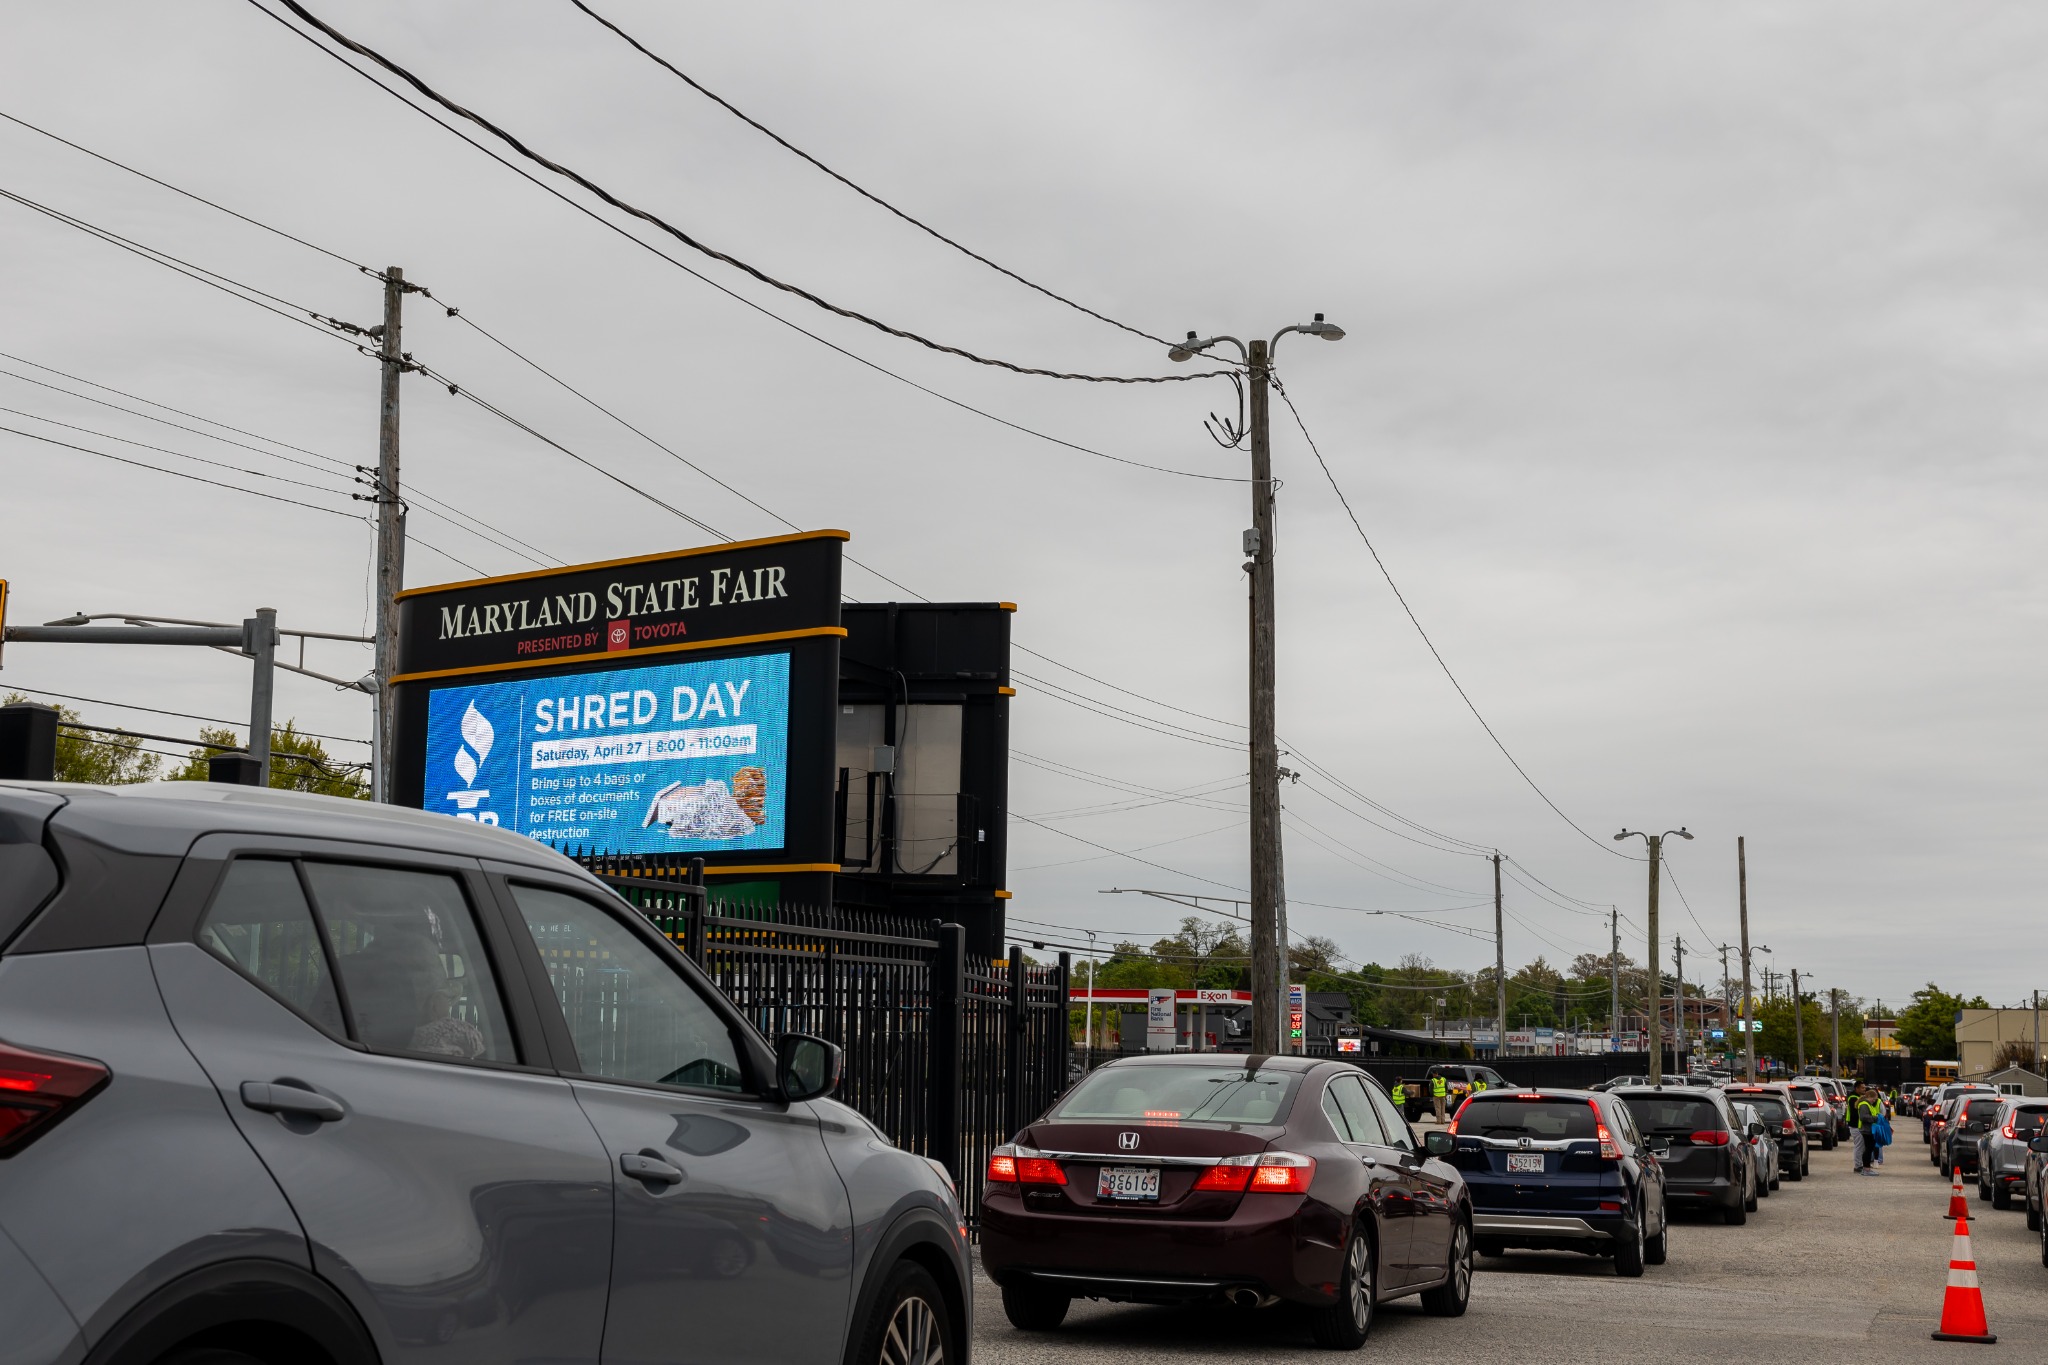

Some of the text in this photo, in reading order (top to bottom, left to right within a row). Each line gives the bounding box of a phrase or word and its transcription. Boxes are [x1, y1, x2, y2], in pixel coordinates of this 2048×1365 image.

[439, 565, 789, 641] MARYLAND STATE FAIR
[517, 621, 687, 655] PRESENTED BY TOYOTA
[535, 680, 751, 733] SHRED DAY
[536, 743, 591, 764] Saturday,
[593, 742, 623, 762] April
[626, 741, 643, 756] 27
[656, 738, 686, 754] 8:00
[698, 732, 752, 752] 11:00am
[531, 773, 647, 791] Bring up to 4 bags or
[530, 788, 640, 806] boxes of documents
[529, 806, 618, 824] for FREE on-site
[528, 826, 590, 840] destruction
[1200, 990, 1228, 1002] Exxon
